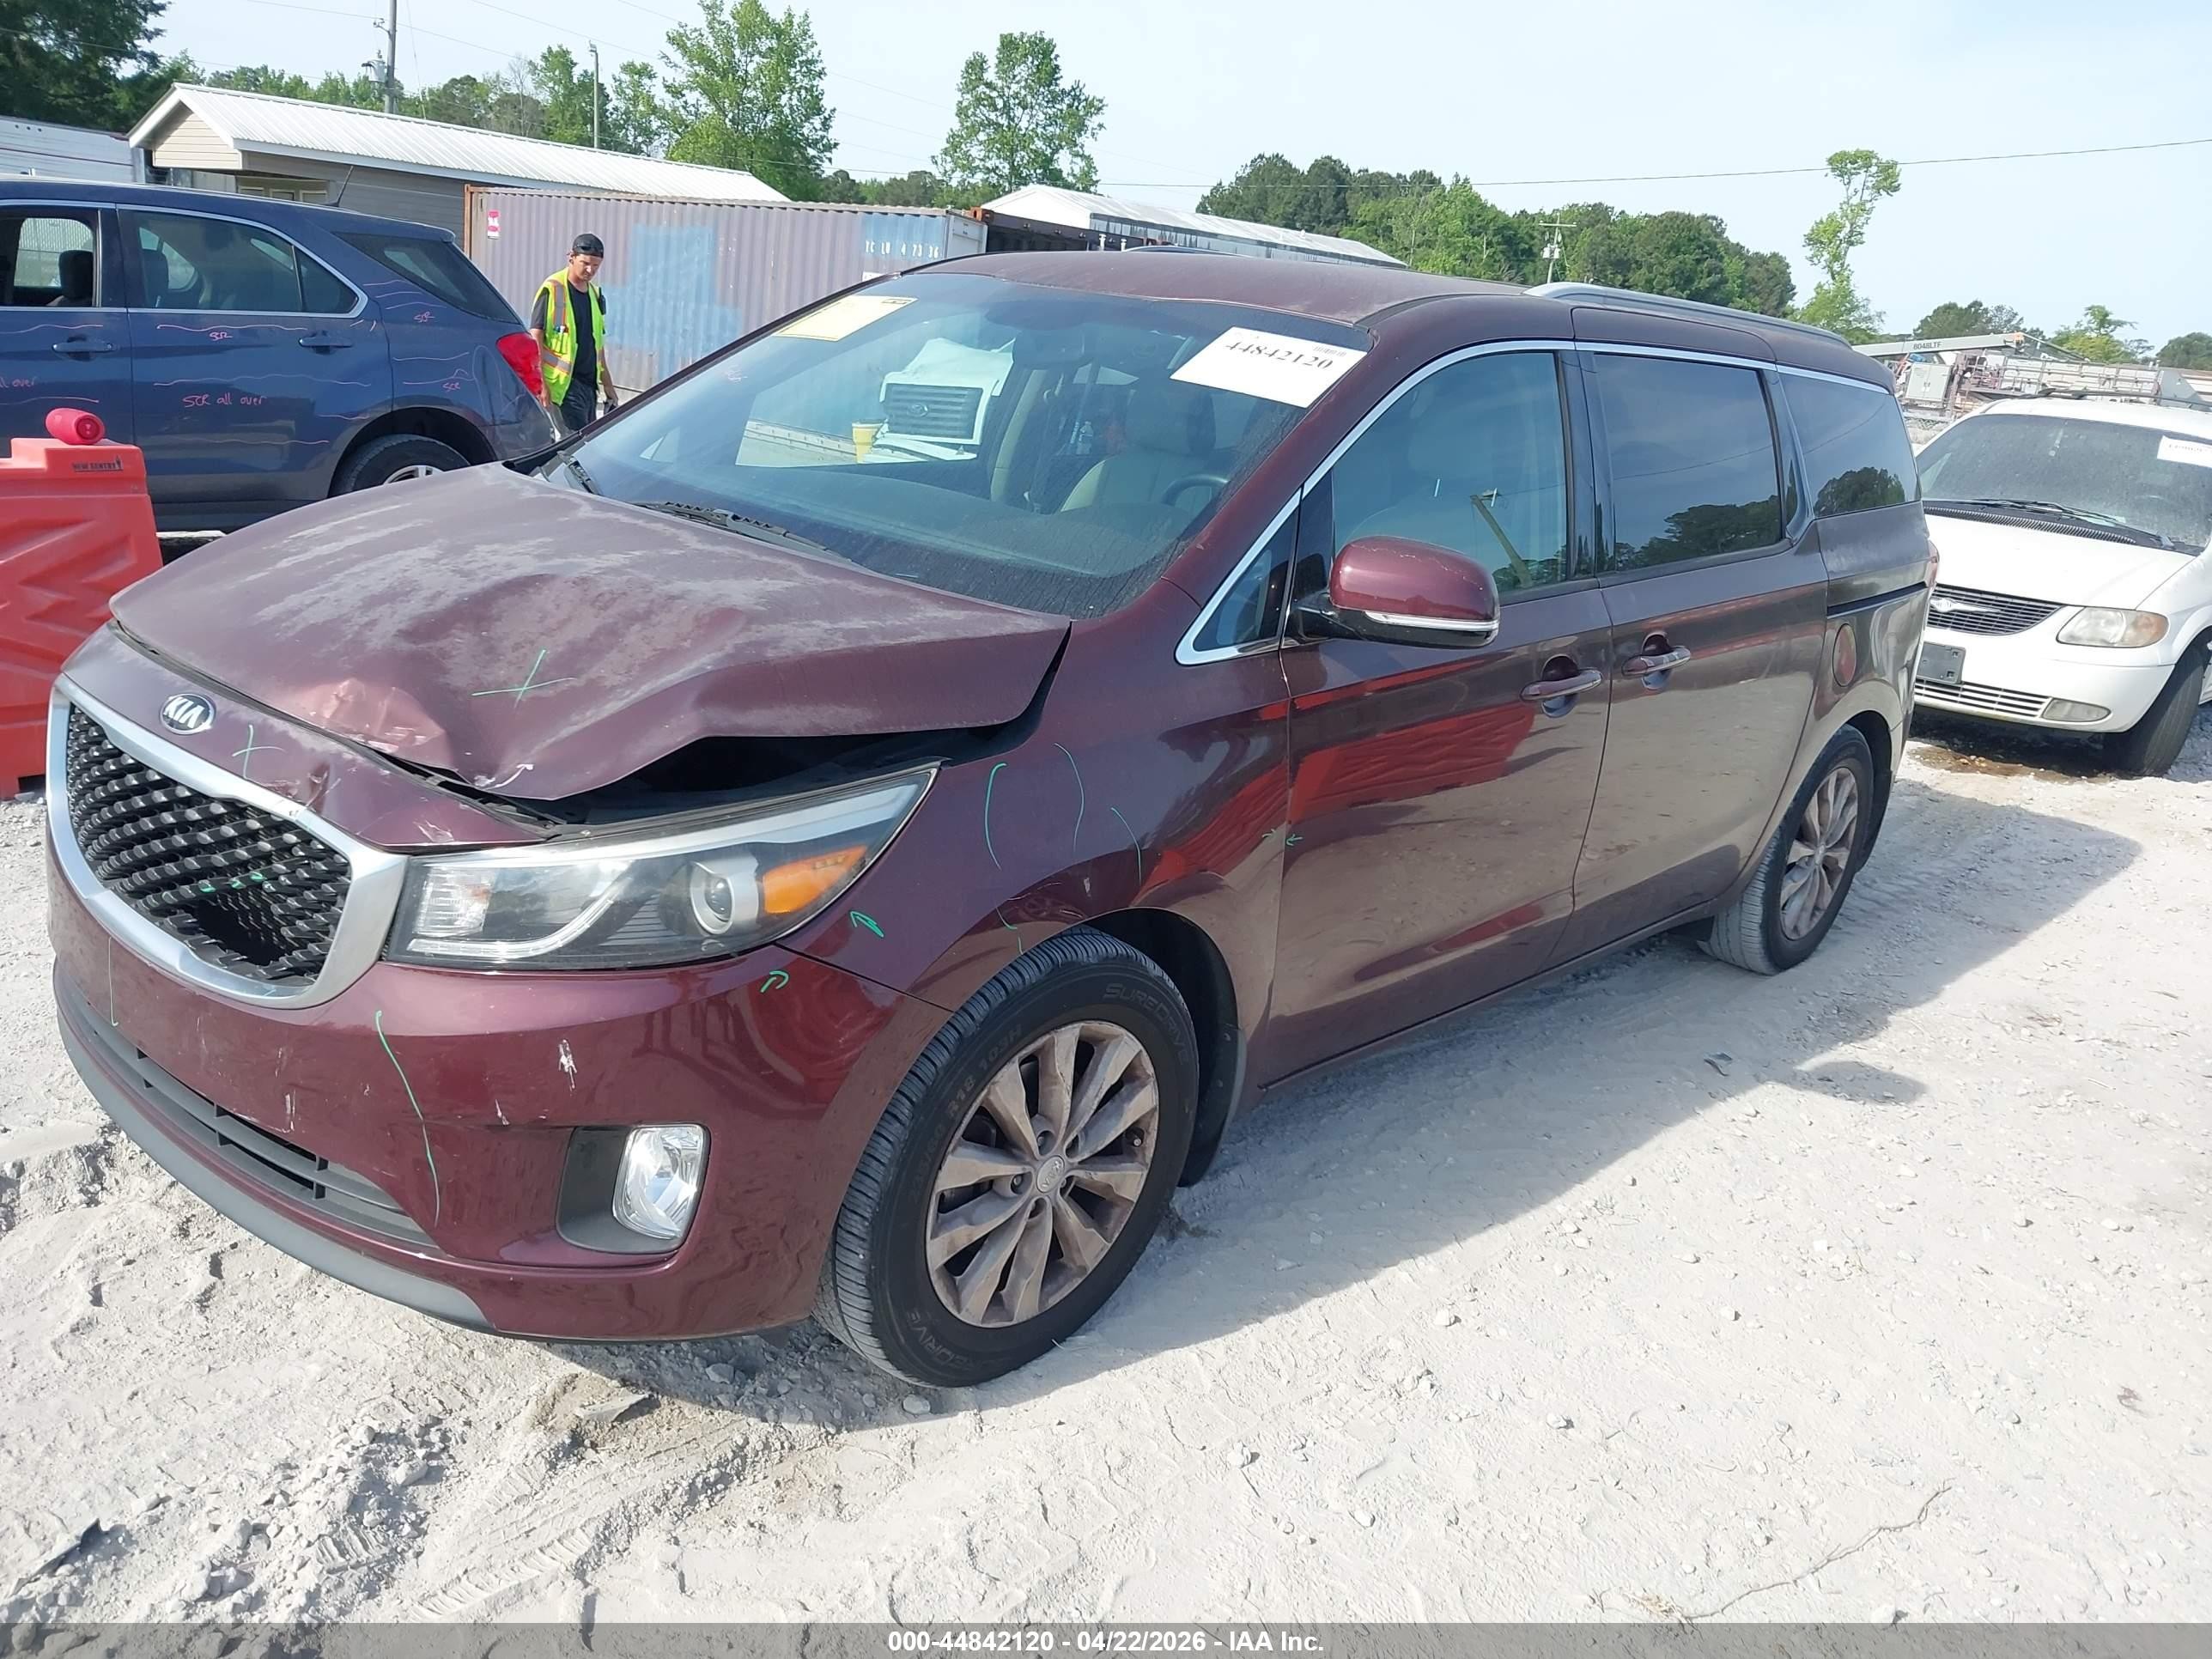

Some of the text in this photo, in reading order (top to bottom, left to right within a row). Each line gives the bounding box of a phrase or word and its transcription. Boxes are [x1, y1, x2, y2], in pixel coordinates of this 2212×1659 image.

[1225, 342, 1333, 369] 44842120
[216, 392, 232, 405] all
[240, 396, 268, 405] over
[162, 696, 205, 729] KIA
